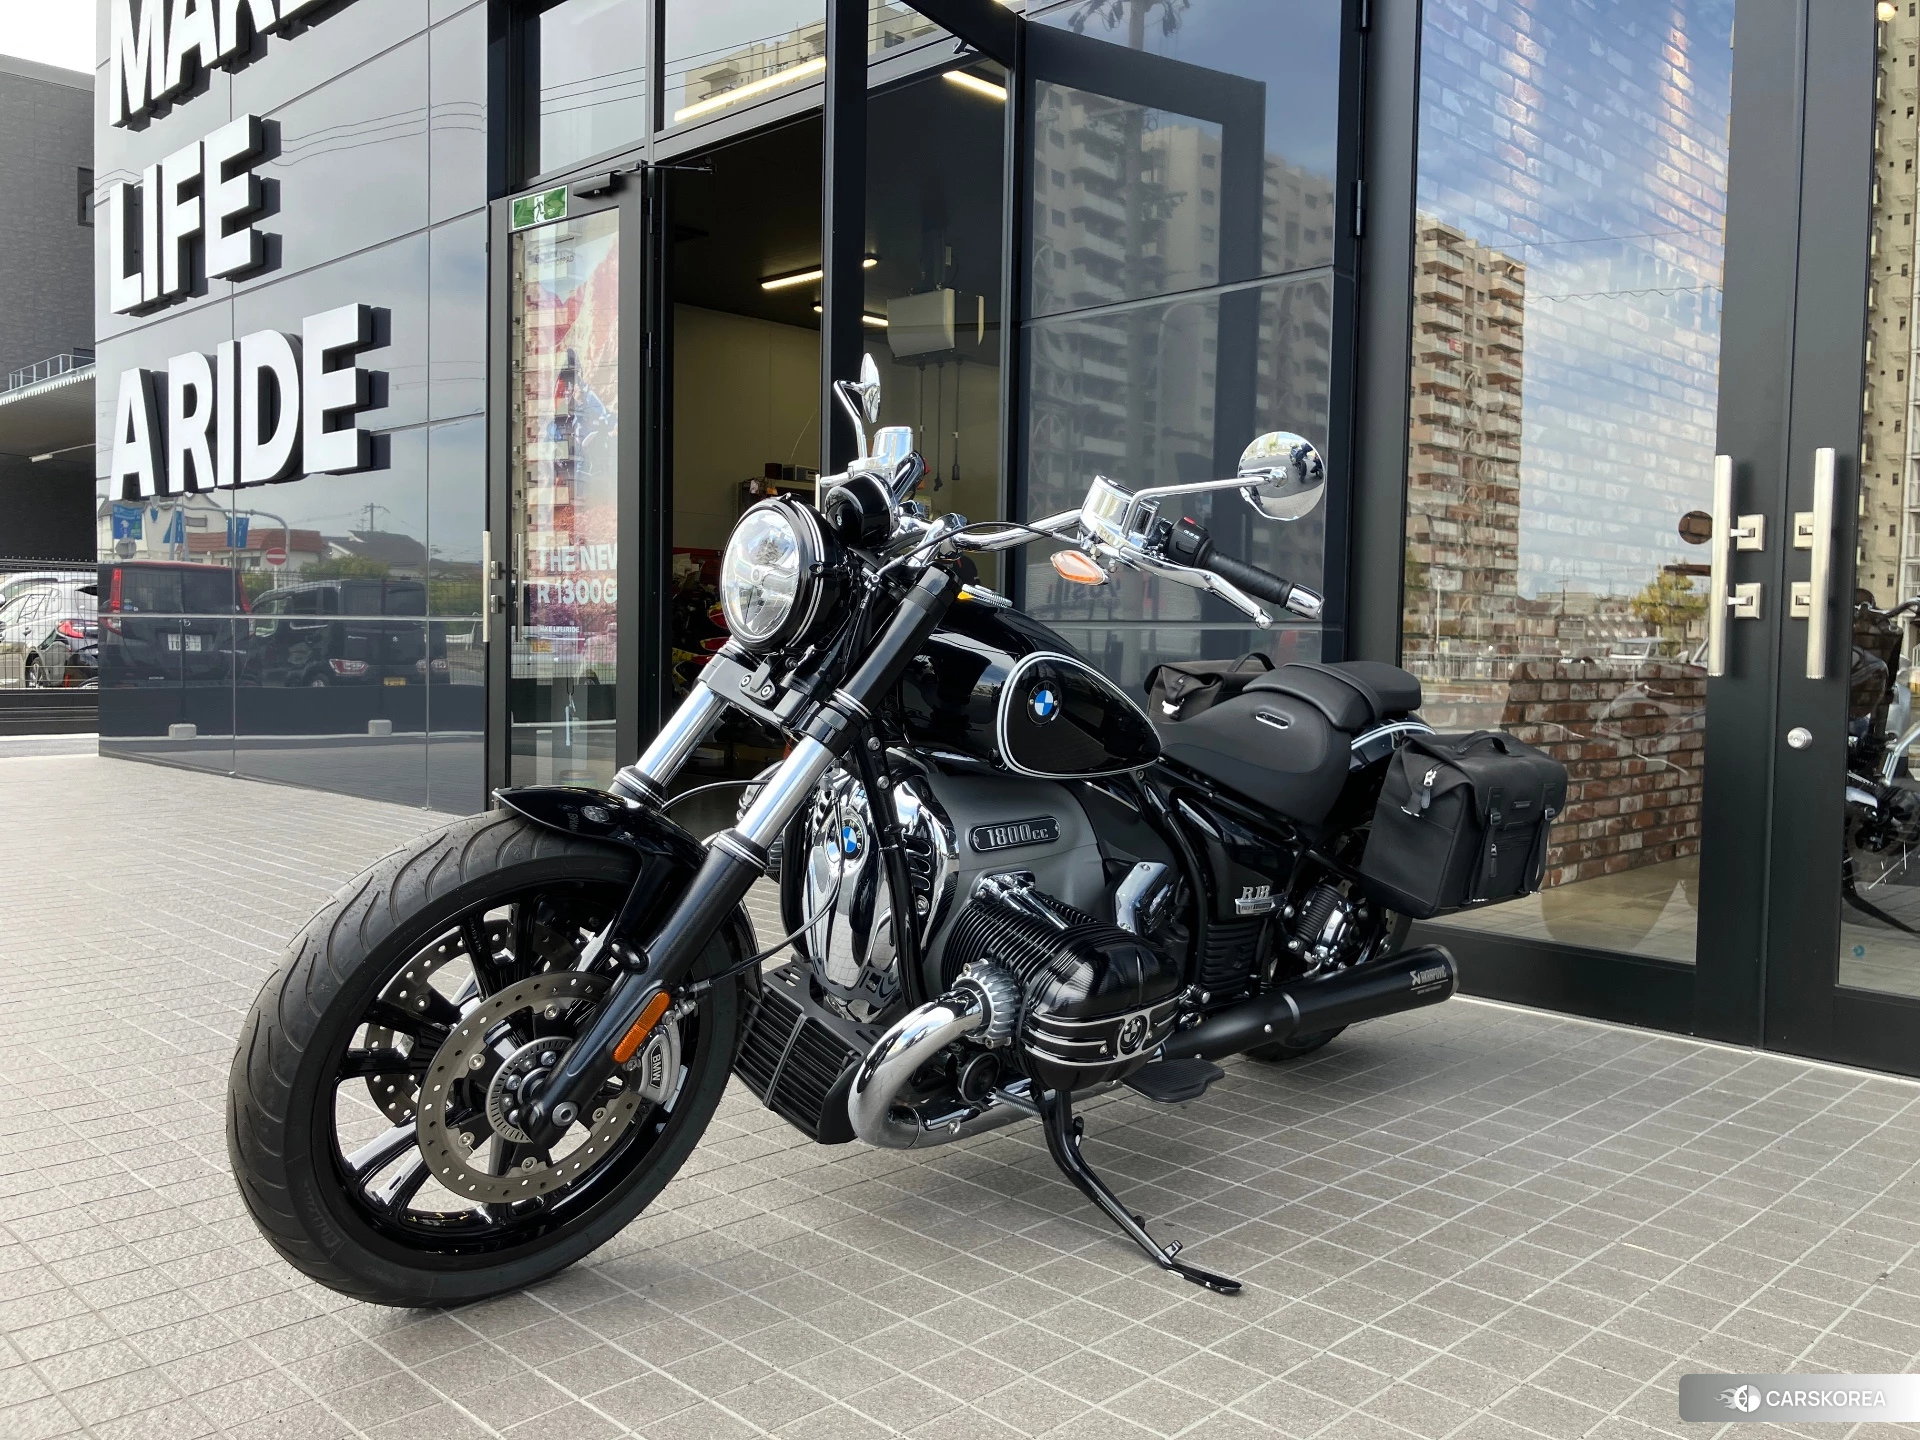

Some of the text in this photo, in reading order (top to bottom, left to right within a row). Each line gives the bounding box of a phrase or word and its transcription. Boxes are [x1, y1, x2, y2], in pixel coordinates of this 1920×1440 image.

[110, 0, 335, 127] MA
[110, 113, 262, 315] LIFE
[537, 545, 576, 572] THE
[537, 580, 551, 604] R
[986, 823, 1049, 847] 1800cc
[653, 1054, 661, 1080] BMW
